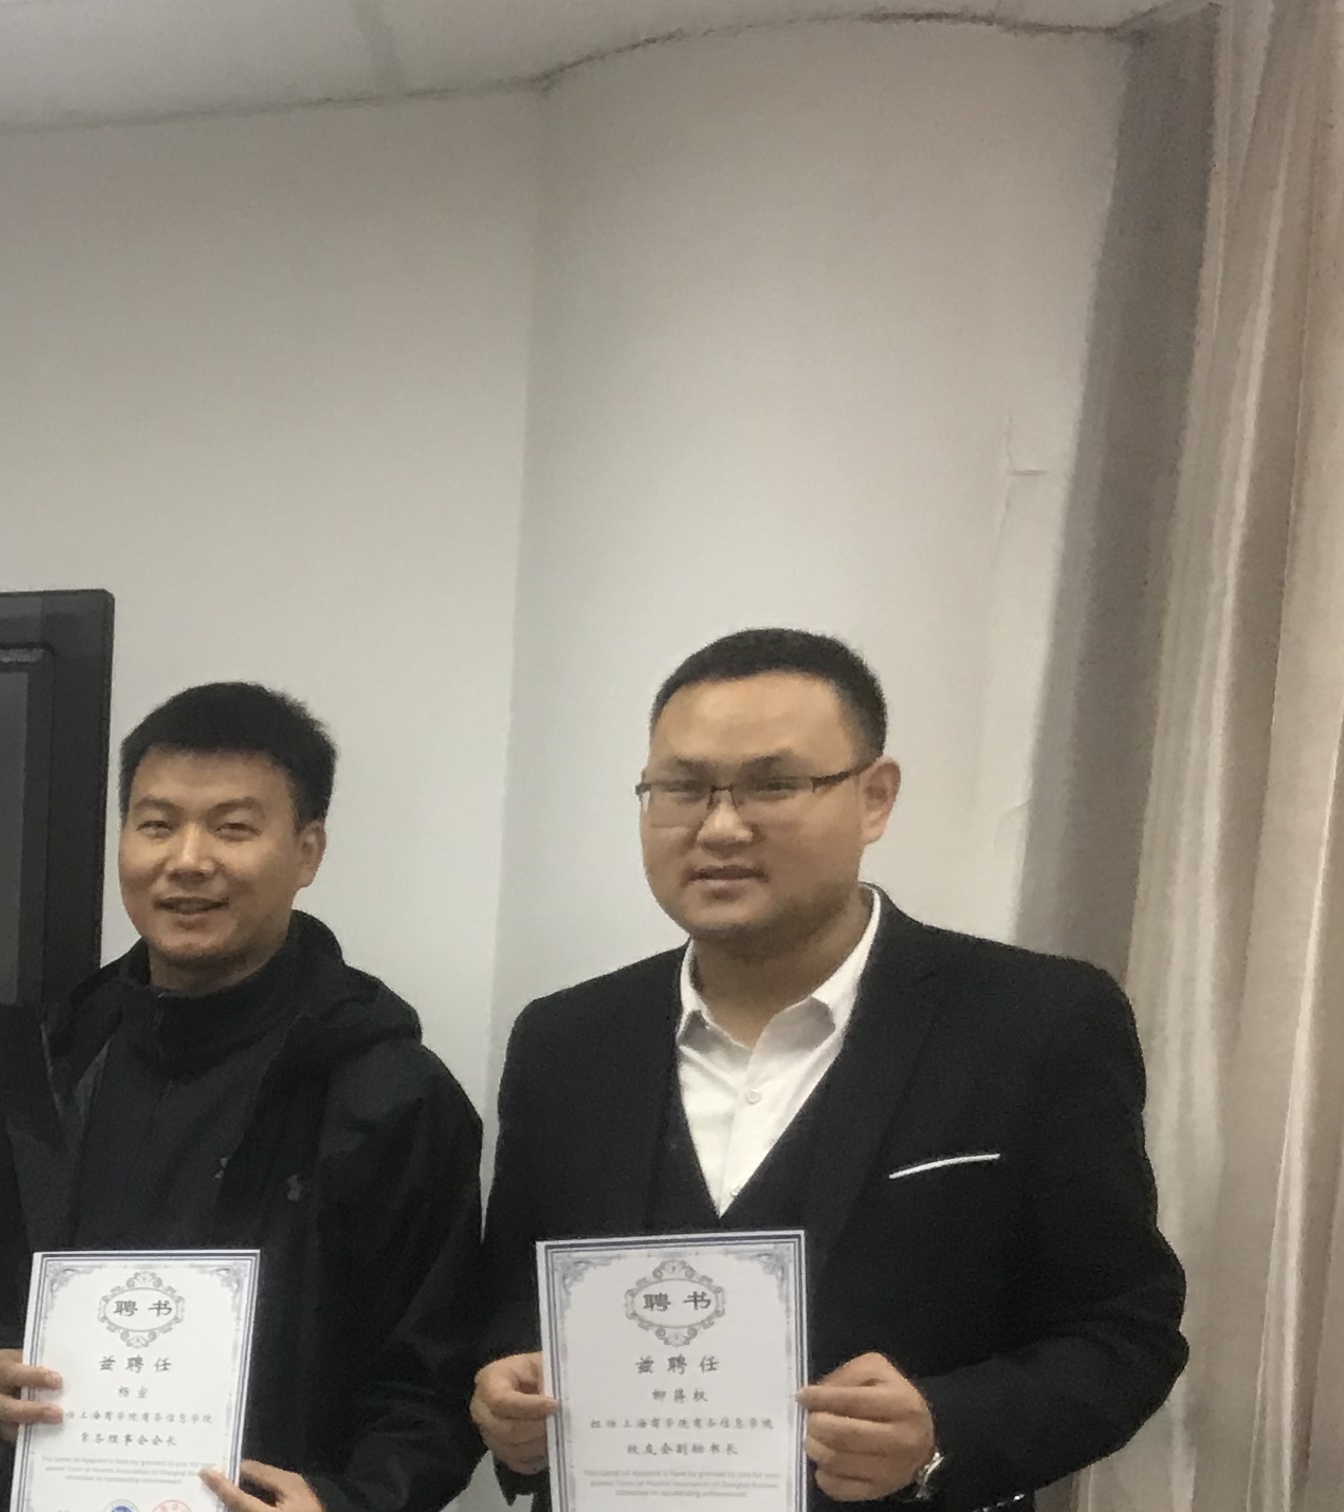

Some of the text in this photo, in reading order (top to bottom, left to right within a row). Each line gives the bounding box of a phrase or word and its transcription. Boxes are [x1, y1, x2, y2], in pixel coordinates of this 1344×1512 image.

[113, 1299, 172, 1317] 聘书
[642, 1290, 711, 1312] 聘书
[99, 1355, 172, 1374] 兹聘任
[635, 1353, 719, 1375] 兹聘任
